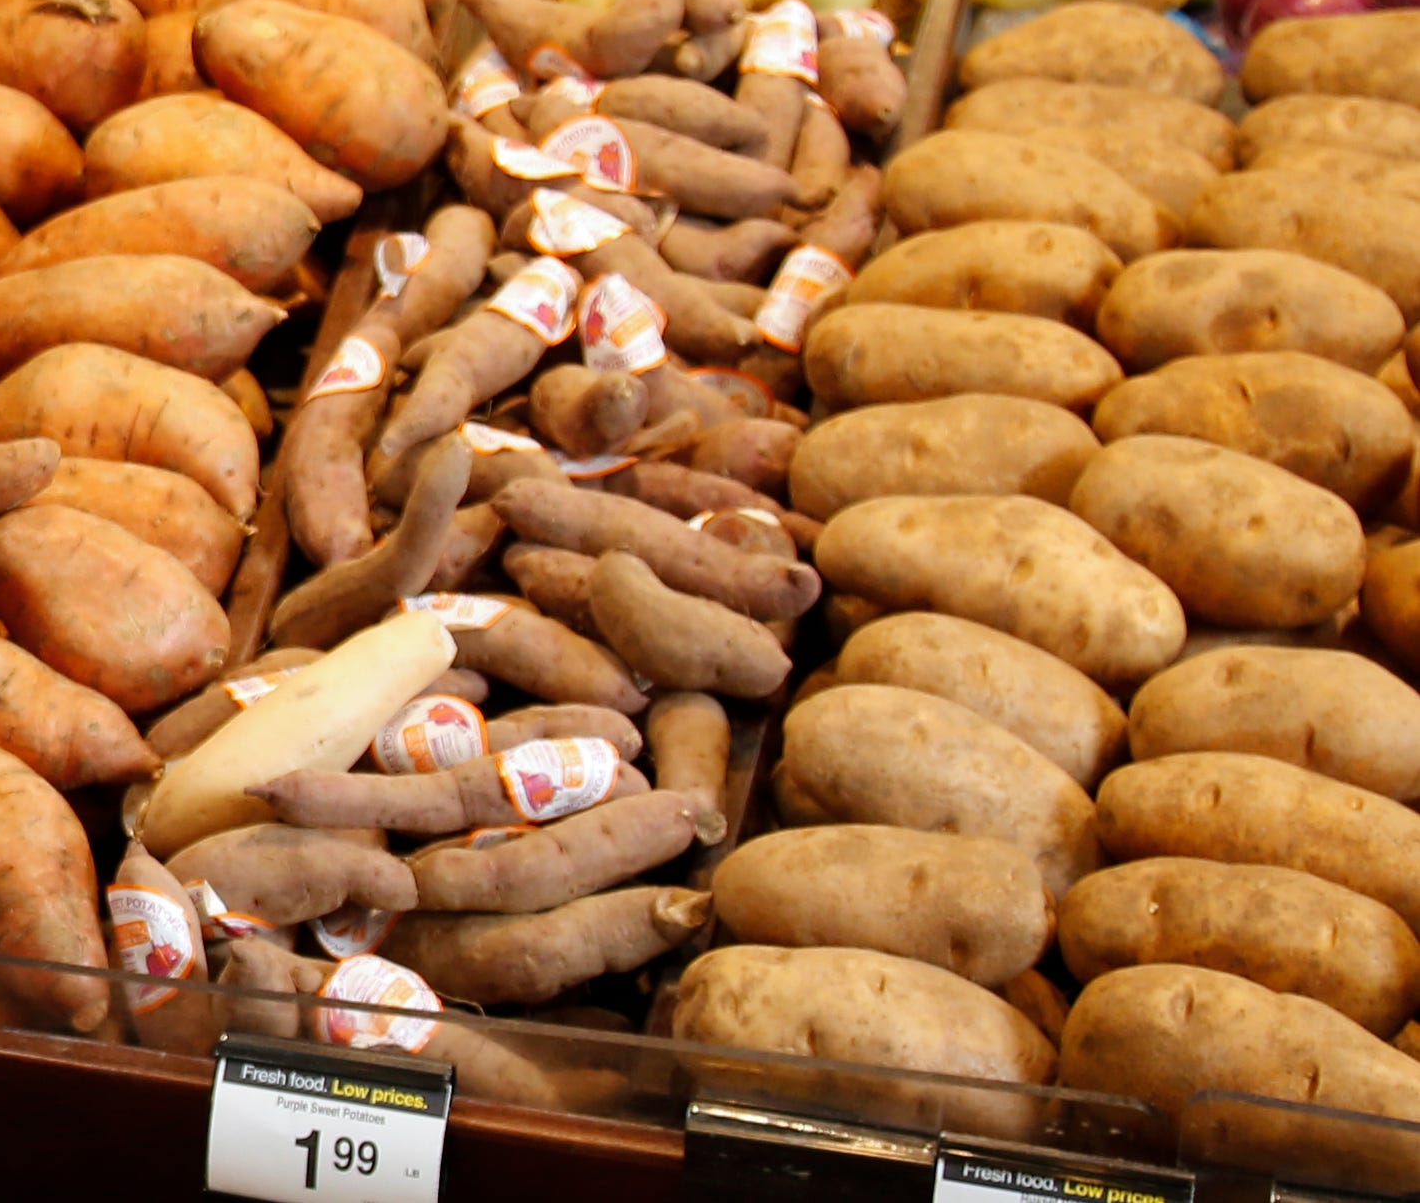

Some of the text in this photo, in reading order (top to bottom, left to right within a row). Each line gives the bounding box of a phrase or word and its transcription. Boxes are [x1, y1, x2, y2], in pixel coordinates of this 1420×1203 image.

[240, 1064, 428, 1110] Fresh food. Low prices.
[277, 1096, 386, 1125] Purple Sweet Potatoes
[295, 1129, 321, 1190] 1
[333, 1137, 379, 1176] 99
[962, 1163, 1012, 1184] Fresh
[1015, 1172, 1058, 1193] food.
[1063, 1180, 1103, 1199] Low
[1106, 1188, 1164, 1203] prices
